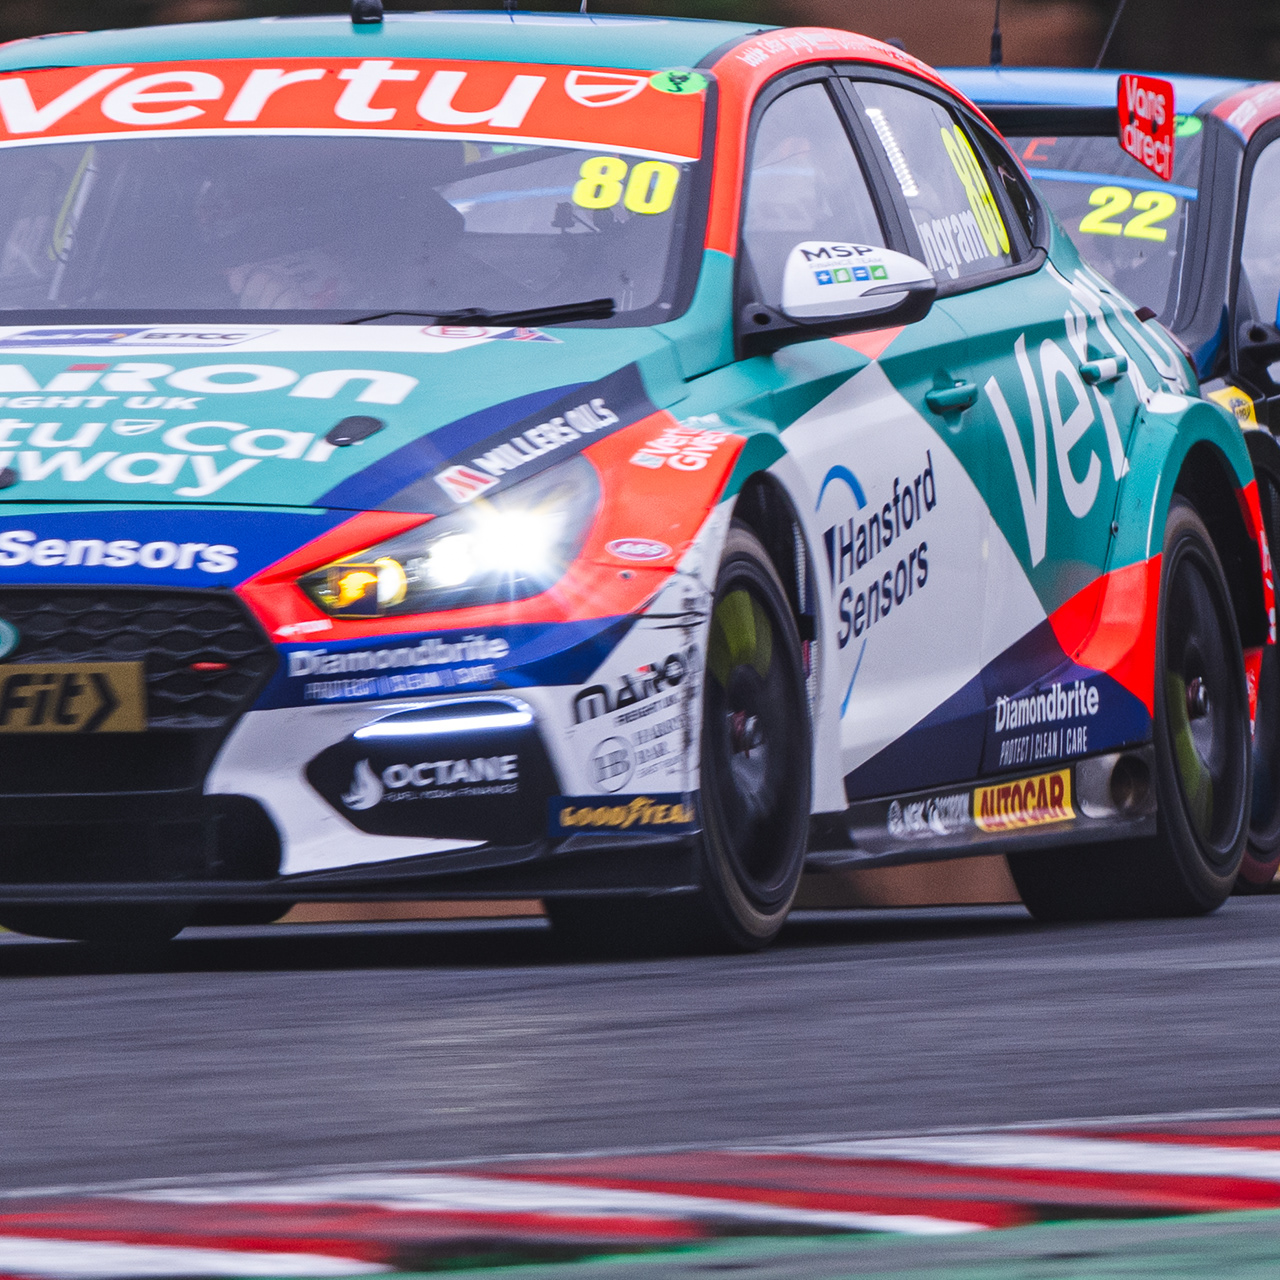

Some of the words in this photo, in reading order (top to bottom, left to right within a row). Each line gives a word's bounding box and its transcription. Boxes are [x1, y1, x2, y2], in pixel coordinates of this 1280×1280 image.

[1125, 74, 1166, 125] Vans
[1124, 120, 1172, 181] direct
[572, 156, 679, 215] 80
[940, 124, 1010, 257] 80
[1079, 186, 1176, 242] 22
[800, 246, 873, 261] MSP
[142, 332, 248, 341] BTCC
[124, 396, 207, 410] UK
[471, 417, 581, 475] MILLERS
[565, 397, 619, 434] OILS
[838, 449, 937, 585] Hansford
[837, 541, 928, 650] Sensors
[288, 634, 510, 677] Diamondbrite
[995, 680, 1099, 733] Diamondbrite
[382, 754, 519, 788] OCTANE
[999, 734, 1029, 767] PROTECT
[1034, 731, 1058, 760] CLEAN
[1066, 726, 1088, 754] CARE
[981, 773, 1068, 828] AUTOCAR
